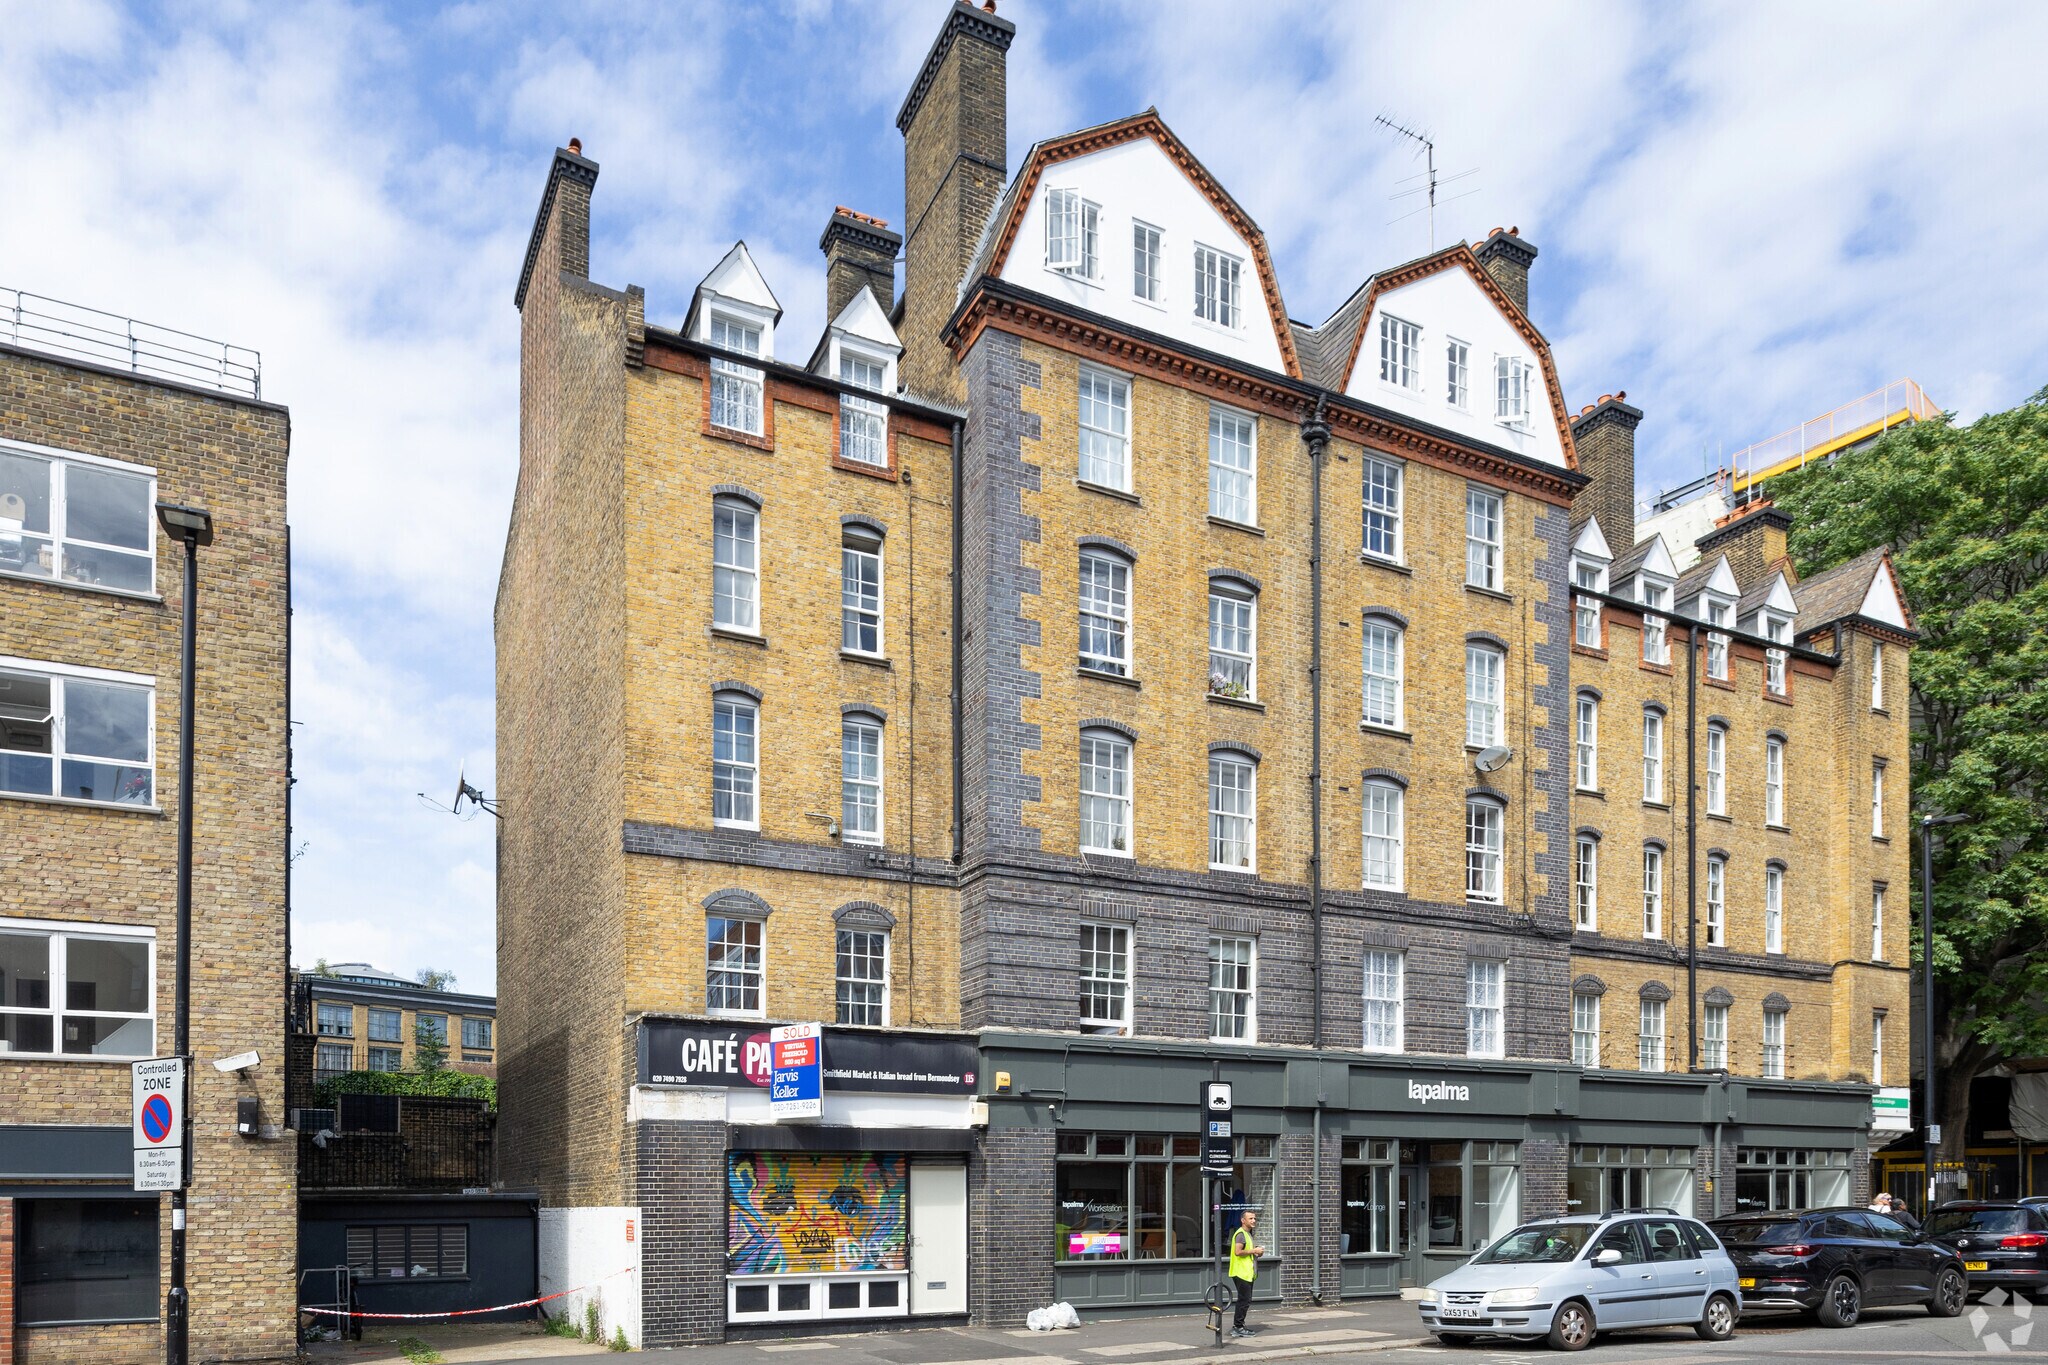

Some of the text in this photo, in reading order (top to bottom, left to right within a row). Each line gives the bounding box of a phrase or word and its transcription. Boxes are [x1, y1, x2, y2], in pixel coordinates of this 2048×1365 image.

[783, 1025, 811, 1039] SOLD
[784, 1042, 806, 1050] VIRTUAL
[682, 1033, 739, 1074] CAFÉ
[782, 1049, 808, 1058] FREEHOLD
[137, 1062, 177, 1075] Controlled
[773, 1069, 799, 1087] Jarvis
[823, 1069, 960, 1084] Smithfield Market & Italian bread from Bermondsey
[965, 1074, 974, 1083] 115
[143, 1077, 171, 1090] ZONE
[773, 1085, 800, 1099] Keller
[1408, 1079, 1470, 1105] lapalma
[148, 1150, 166, 1158] Mon-Fri
[1062, 1201, 1084, 1209] lapalma
